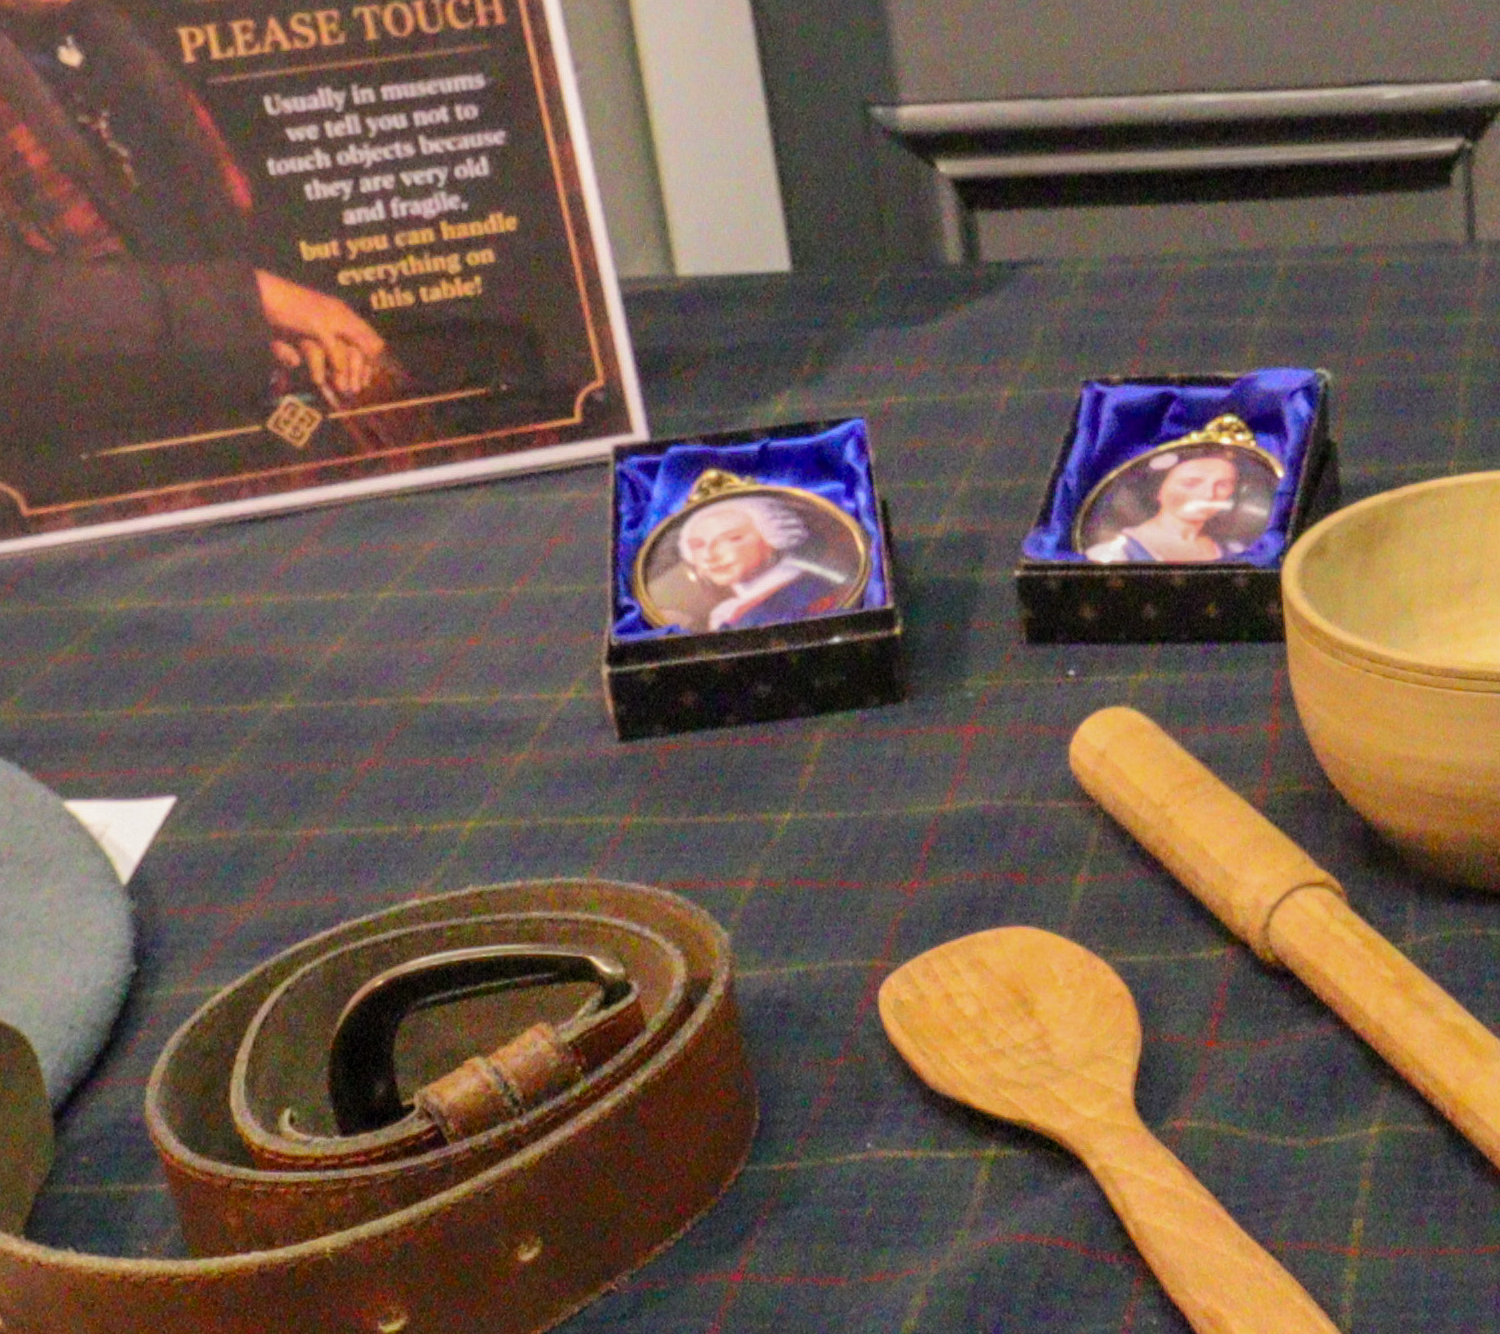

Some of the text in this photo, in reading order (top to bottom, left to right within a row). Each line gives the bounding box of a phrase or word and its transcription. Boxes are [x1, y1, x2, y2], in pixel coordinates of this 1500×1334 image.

[176, 9, 347, 64] PLEASE
[263, 73, 486, 116] Usually in museums
[285, 103, 479, 142] we tell you not to
[266, 129, 507, 176] touch objects because
[303, 156, 489, 201] they are very old
[343, 200, 385, 226] and
[300, 211, 519, 262] but you can handle
[337, 248, 496, 286] everything on
[370, 275, 483, 310] this table!
